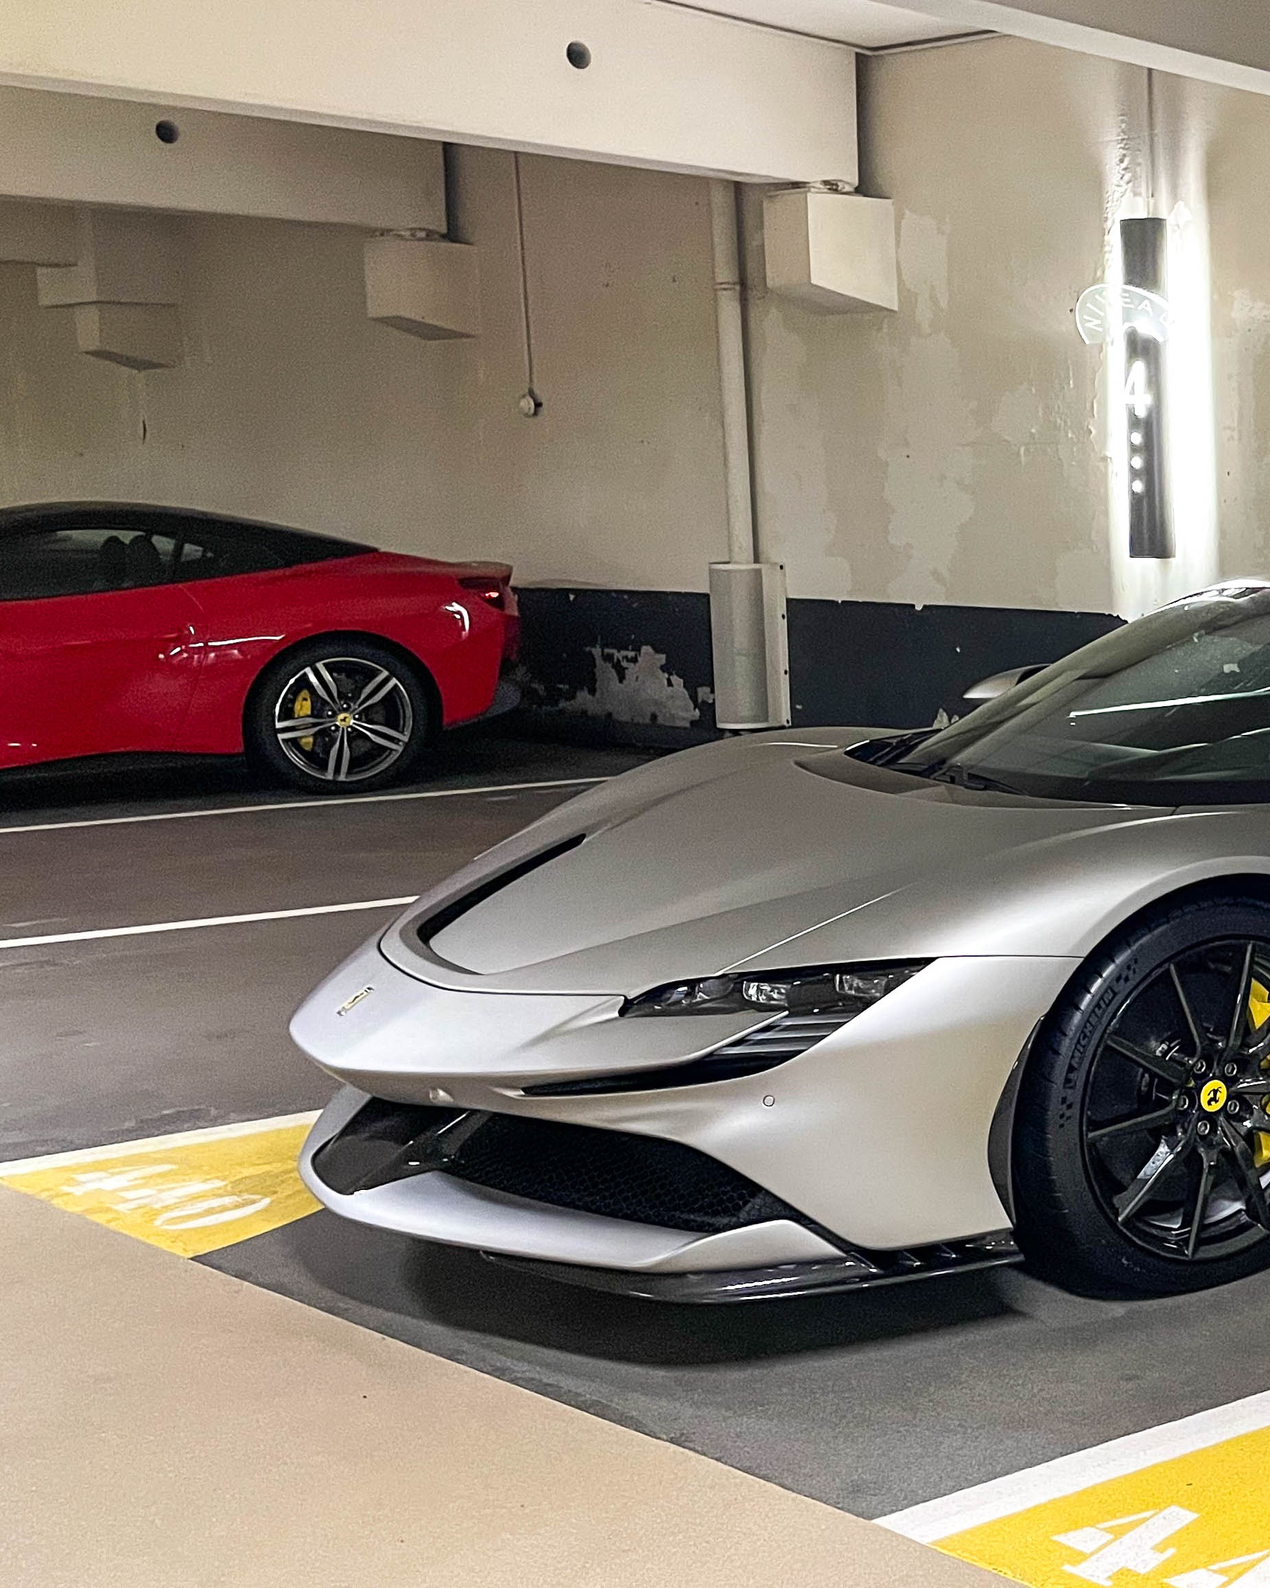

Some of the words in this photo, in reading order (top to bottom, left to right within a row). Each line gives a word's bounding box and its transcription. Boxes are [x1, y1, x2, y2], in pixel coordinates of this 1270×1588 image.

[1123, 359, 1152, 418] 4
[1071, 986, 1116, 1069] MICHELIN
[59, 1164, 271, 1229] 440
